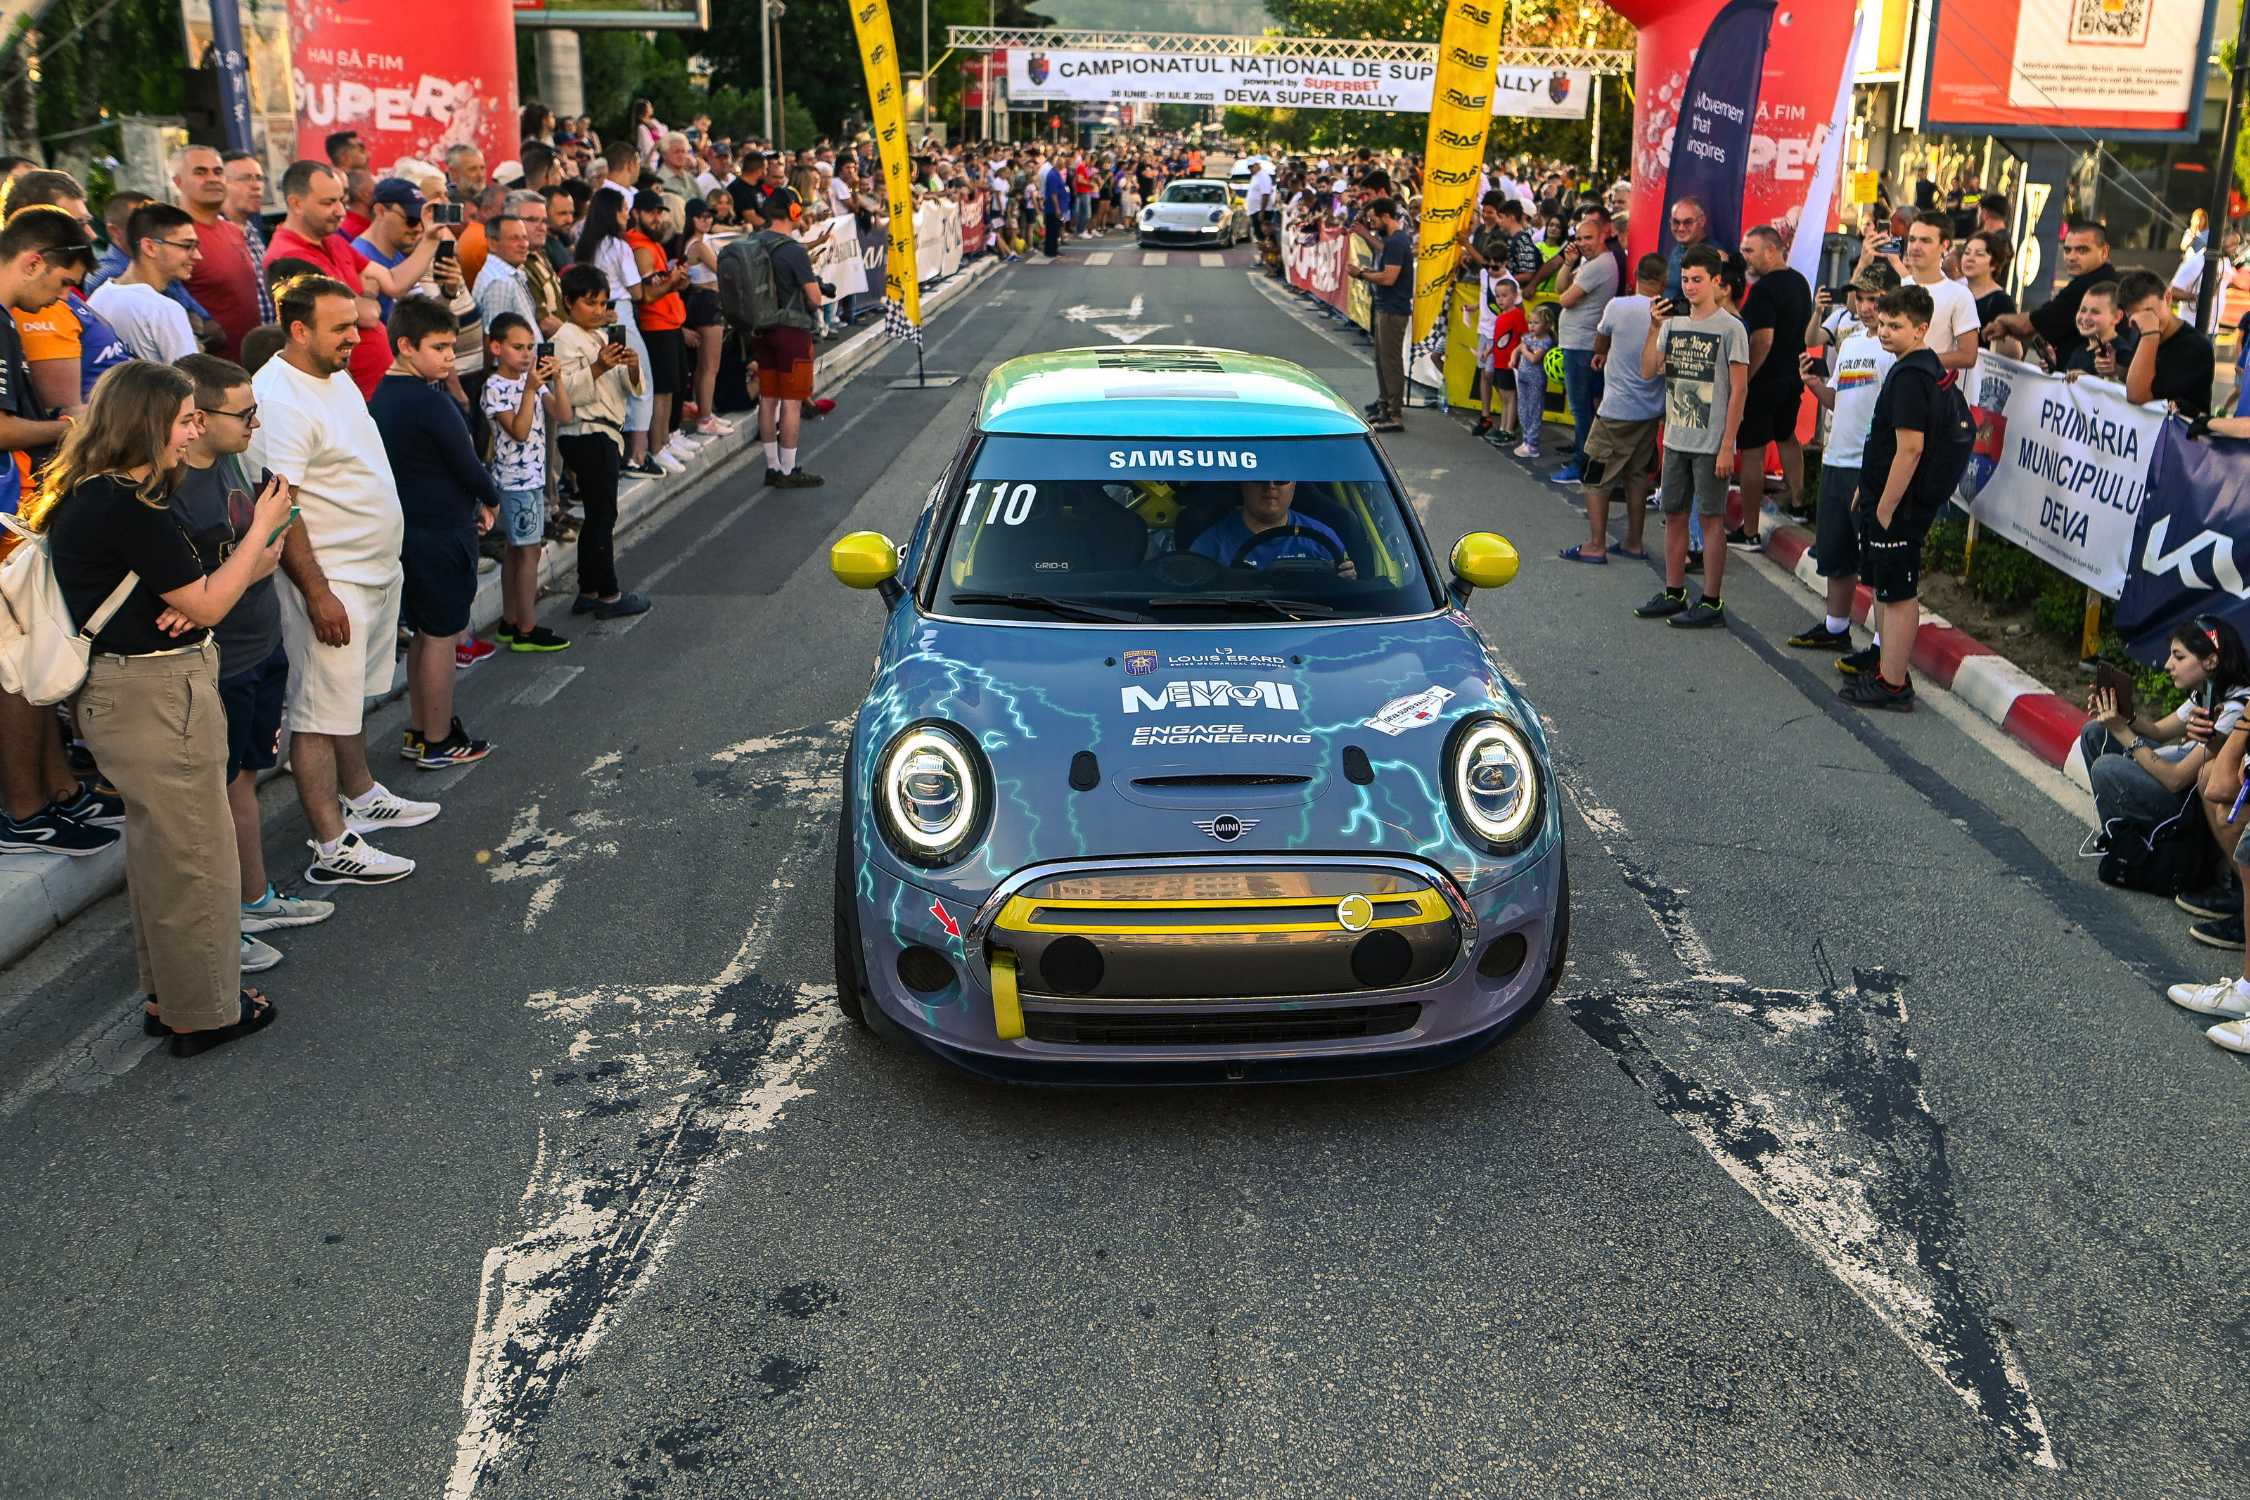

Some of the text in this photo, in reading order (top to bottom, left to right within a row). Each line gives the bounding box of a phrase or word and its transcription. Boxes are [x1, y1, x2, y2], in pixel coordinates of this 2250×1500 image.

[308, 48, 404, 70] HAI SĂ FIM
[1059, 58, 1542, 93] CAMPIONATUL NAȚIONAL DE SUP LLY
[1243, 77, 1381, 91] powered by SUPERBET
[1225, 88, 1398, 107] DEVA SUPER RALLY
[1694, 91, 1745, 125] Movement
[1775, 105, 1806, 121] FIM
[1692, 113, 1712, 135] that
[1687, 137, 1726, 164] inspires
[23, 321, 57, 332] DELL
[2040, 399, 2138, 462] PRIMĂRIA
[1109, 449, 1258, 469] SAMSUNG
[2018, 437, 2144, 516] MUNICIPIULU
[959, 482, 1037, 526] 110
[2040, 496, 2090, 548] DEVA
[1168, 655, 1284, 664] LOUIS ERARD
[1131, 733, 1312, 746] ENGINEERING
[1134, 725, 1245, 736] ENGAGE
[1215, 823, 1239, 832] MINI
